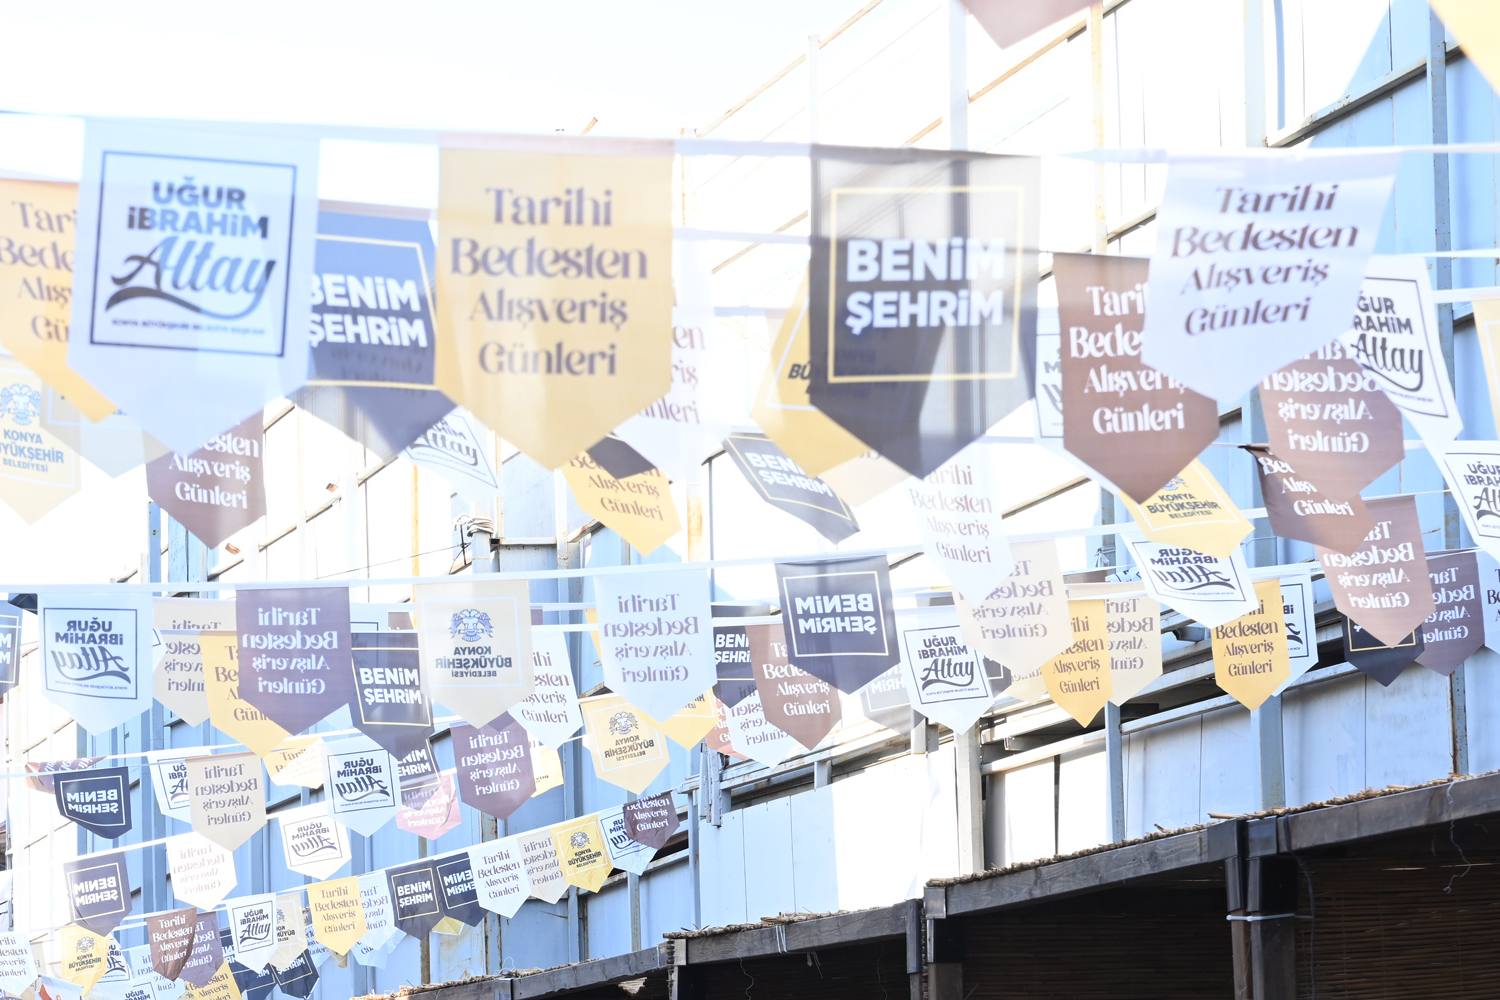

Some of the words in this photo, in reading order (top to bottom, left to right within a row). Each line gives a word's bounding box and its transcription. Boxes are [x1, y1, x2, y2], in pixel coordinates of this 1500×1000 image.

[485, 188, 613, 227] Tarihi
[1215, 183, 1339, 214] Tarihi
[1171, 222, 1358, 258] Bedesten
[450, 237, 648, 280] Bedesten
[1086, 286, 1145, 317] Tari
[1186, 297, 1311, 336] Günleri
[477, 341, 618, 378] Günleri
[174, 481, 247, 510] Günleri
[600, 496, 664, 522] Günleri
[1216, 619, 1279, 640] Bedesten
[1228, 659, 1272, 676] Günleri
[1059, 677, 1100, 694] Günleri
[477, 861, 521, 878] Bedesten
[483, 851, 511, 865] Tarihi
[319, 887, 349, 901] Tarihi
[489, 885, 520, 899] Günleri
[314, 899, 359, 913] Bedesten
[324, 920, 357, 934] Günleri
